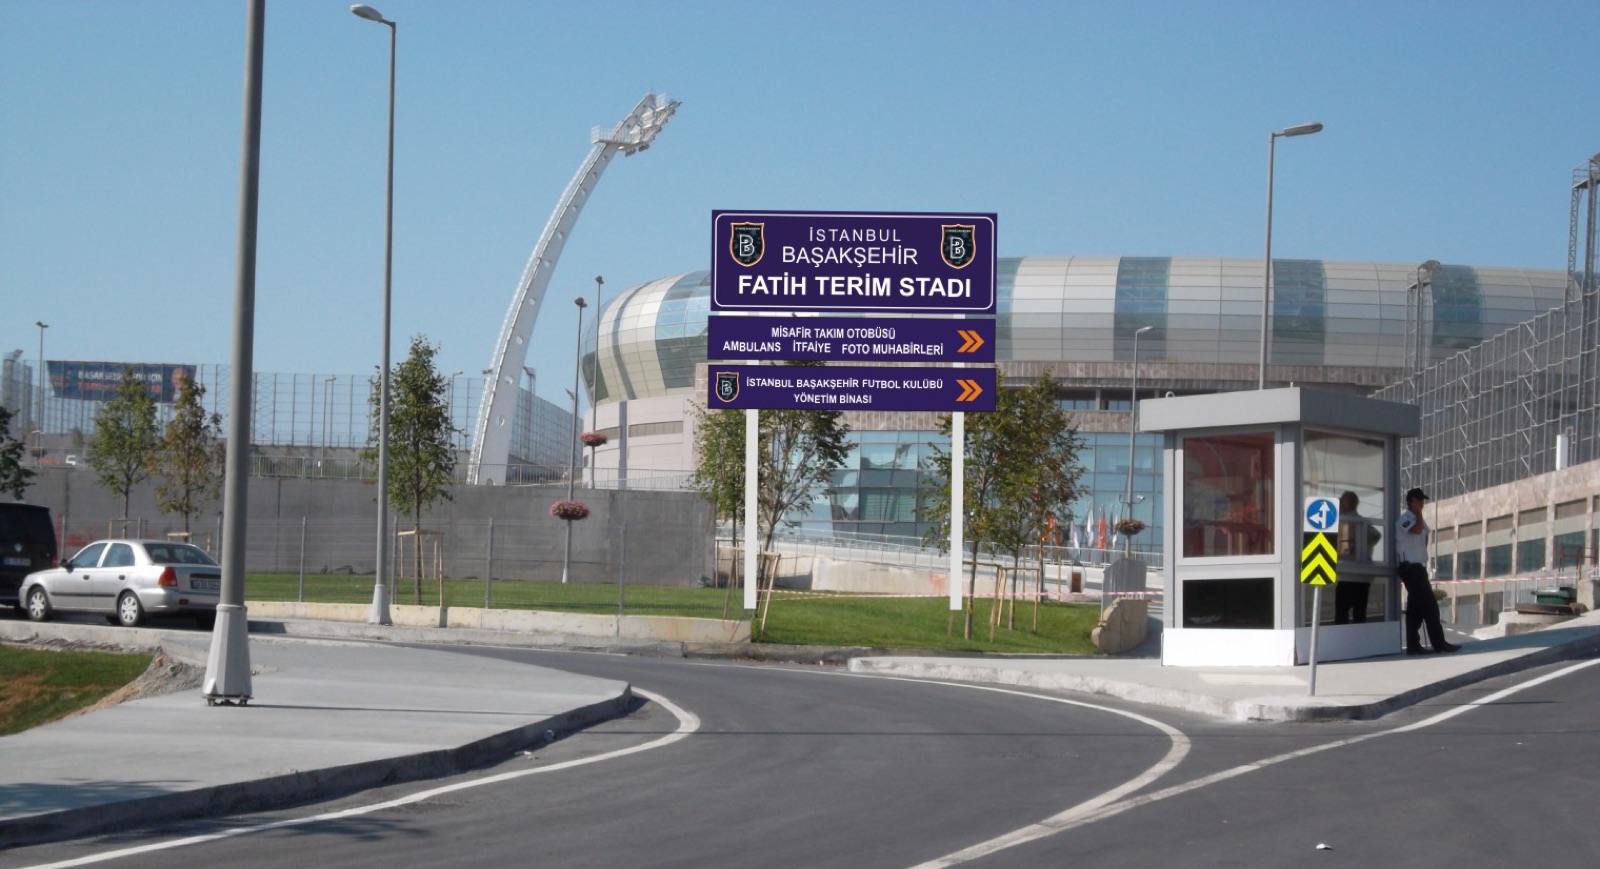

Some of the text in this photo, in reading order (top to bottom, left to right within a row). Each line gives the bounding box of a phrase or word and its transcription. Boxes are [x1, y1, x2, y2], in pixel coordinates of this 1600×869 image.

[809, 227, 901, 242] İSTANBUL
[782, 245, 919, 268] BAŞAKŞEHİR
[738, 271, 971, 298] FATİH TERİM STADI
[771, 325, 896, 340] MİSAFİR TAKIM OTOBÜSÜ
[722, 339, 944, 355] AMBULANS İTFAİYE FOTO MUHABİRLERİ
[746, 376, 943, 390] İSTANBUL BAŞAKŞEHİR FUTBOL KULÜBÜ
[793, 391, 872, 404] YÖNETİM BİNASI
